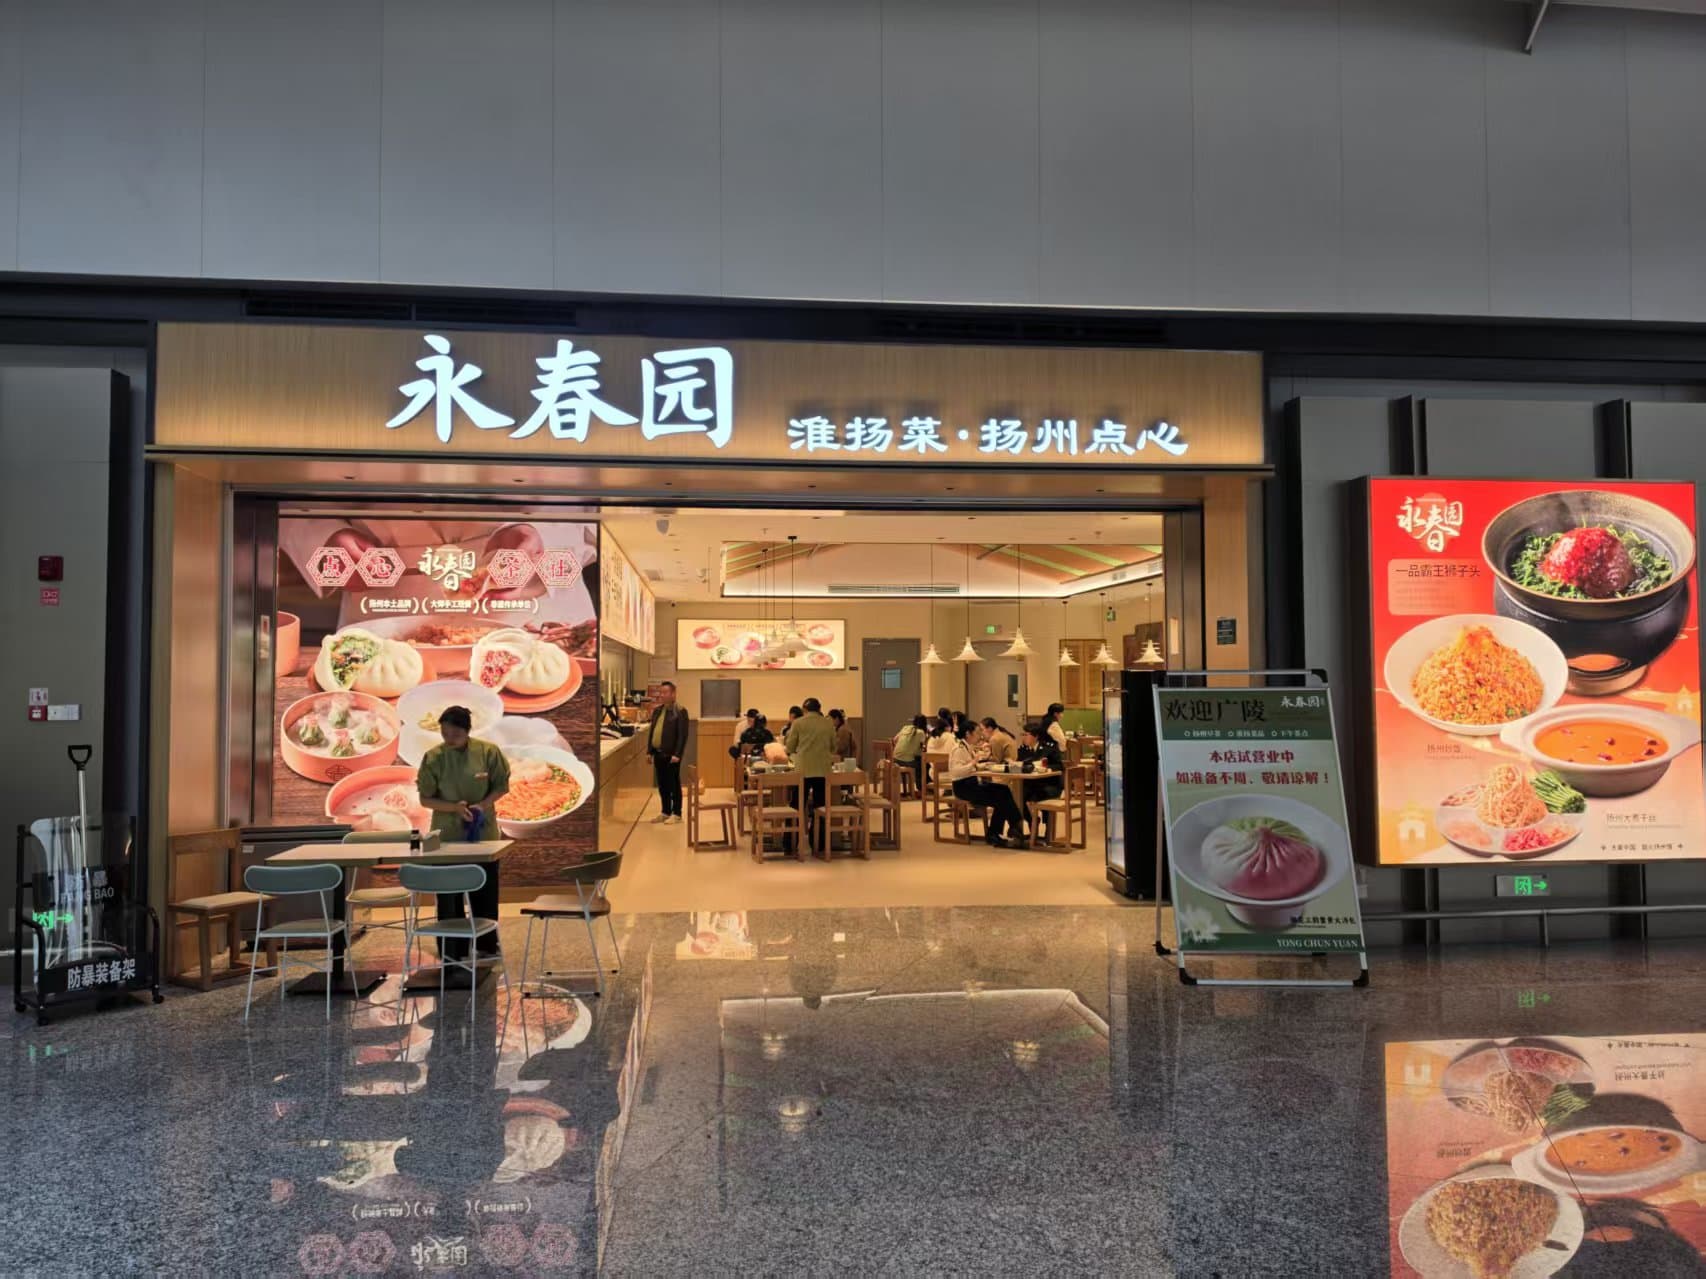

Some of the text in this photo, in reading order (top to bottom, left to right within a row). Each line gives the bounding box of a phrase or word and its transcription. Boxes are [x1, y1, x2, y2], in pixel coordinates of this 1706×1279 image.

[386, 335, 734, 448] 永春园
[787, 416, 1188, 456] 淮扬菜·扬州点心
[1395, 564, 1481, 578] 一品霸王狮子头
[1281, 696, 1320, 708] 永春园
[1165, 699, 1267, 722] 欢迎广陵
[1209, 750, 1295, 764] 本店试营业中
[94, 887, 115, 899] BAO
[1277, 938, 1358, 948] YONG CHUN YUAN
[67, 958, 137, 989] 防暴装备架
